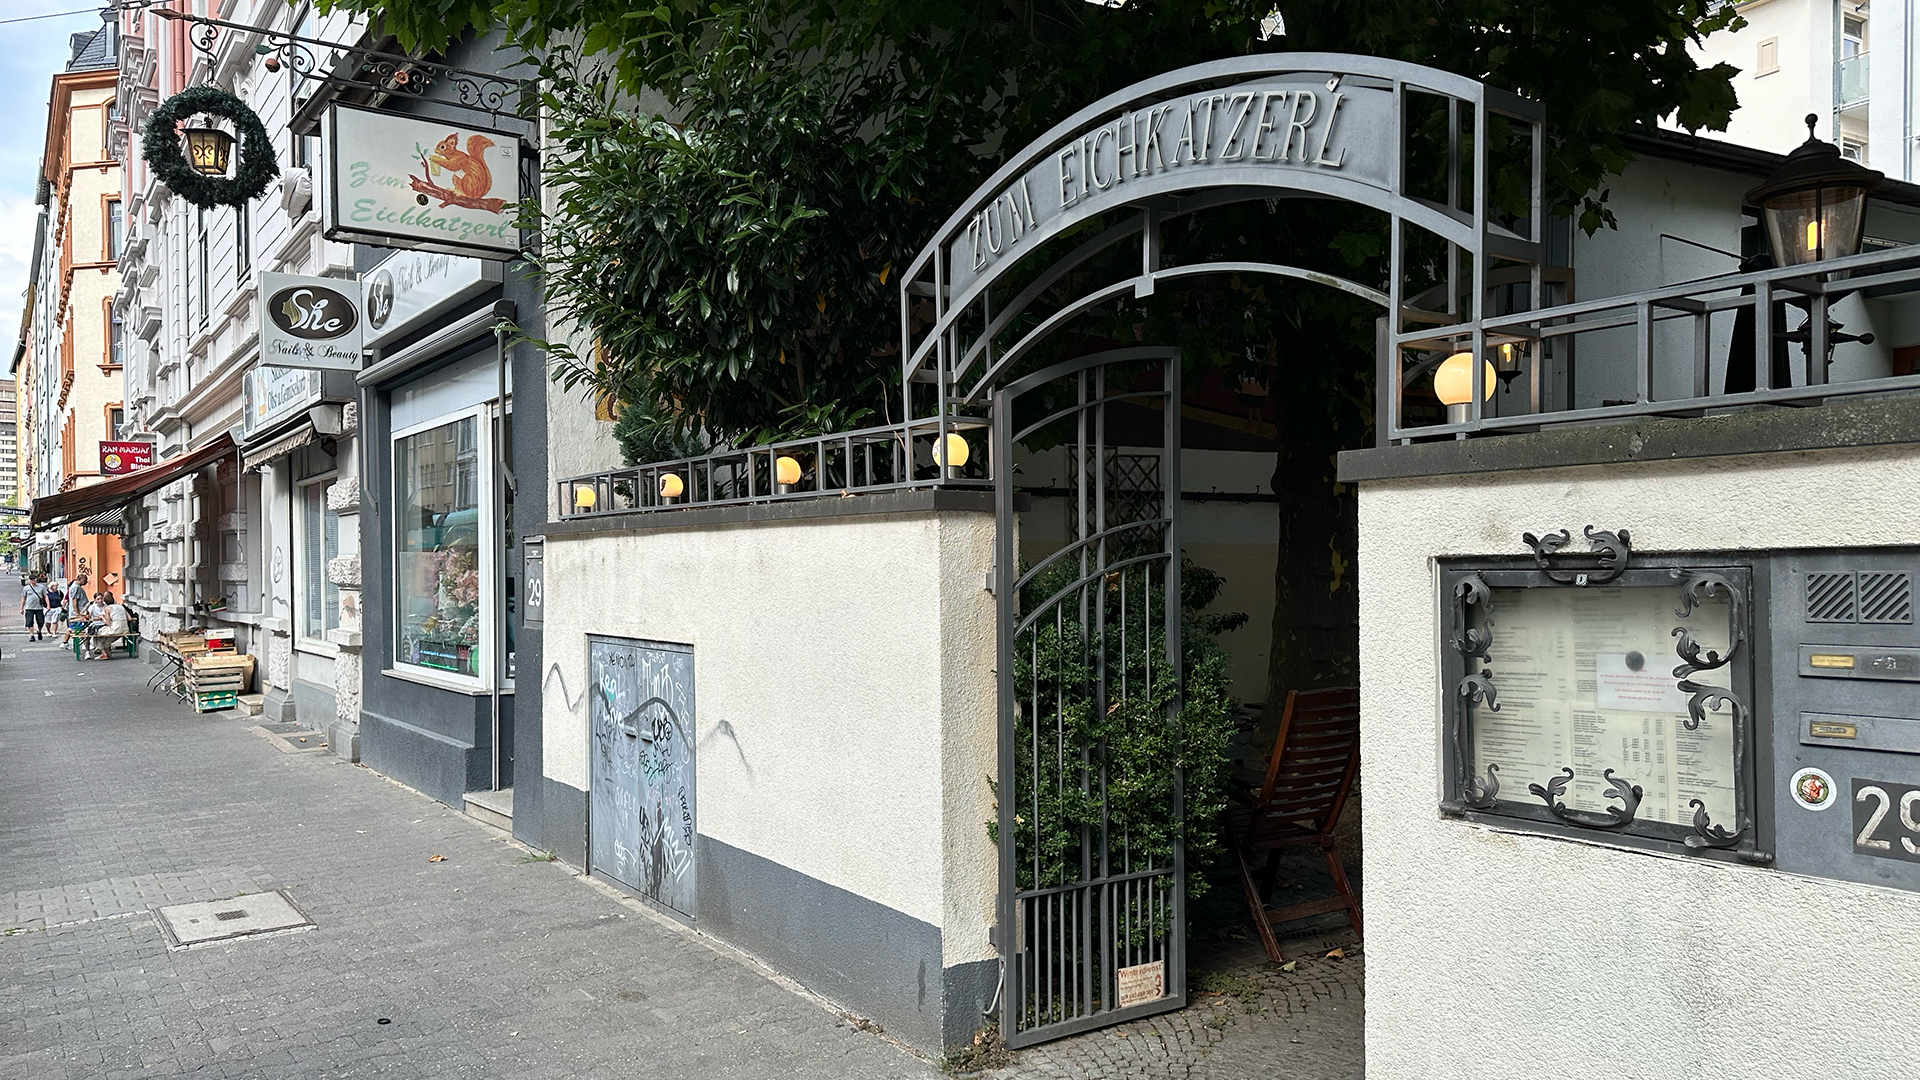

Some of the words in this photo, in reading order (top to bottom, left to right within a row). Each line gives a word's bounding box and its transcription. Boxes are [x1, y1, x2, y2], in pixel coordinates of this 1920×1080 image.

[350, 161, 408, 189] Zum
[967, 175, 1038, 273] ZUM
[1056, 89, 1348, 209] EICHKATZERL
[350, 198, 508, 240] Eichkatzerl
[288, 289, 344, 332] She
[267, 339, 299, 356] Nails
[304, 342, 315, 357] &
[317, 344, 359, 364] Beauty
[101, 445, 118, 453] RAN
[528, 577, 542, 607] 29
[1856, 784, 1920, 855] 29
